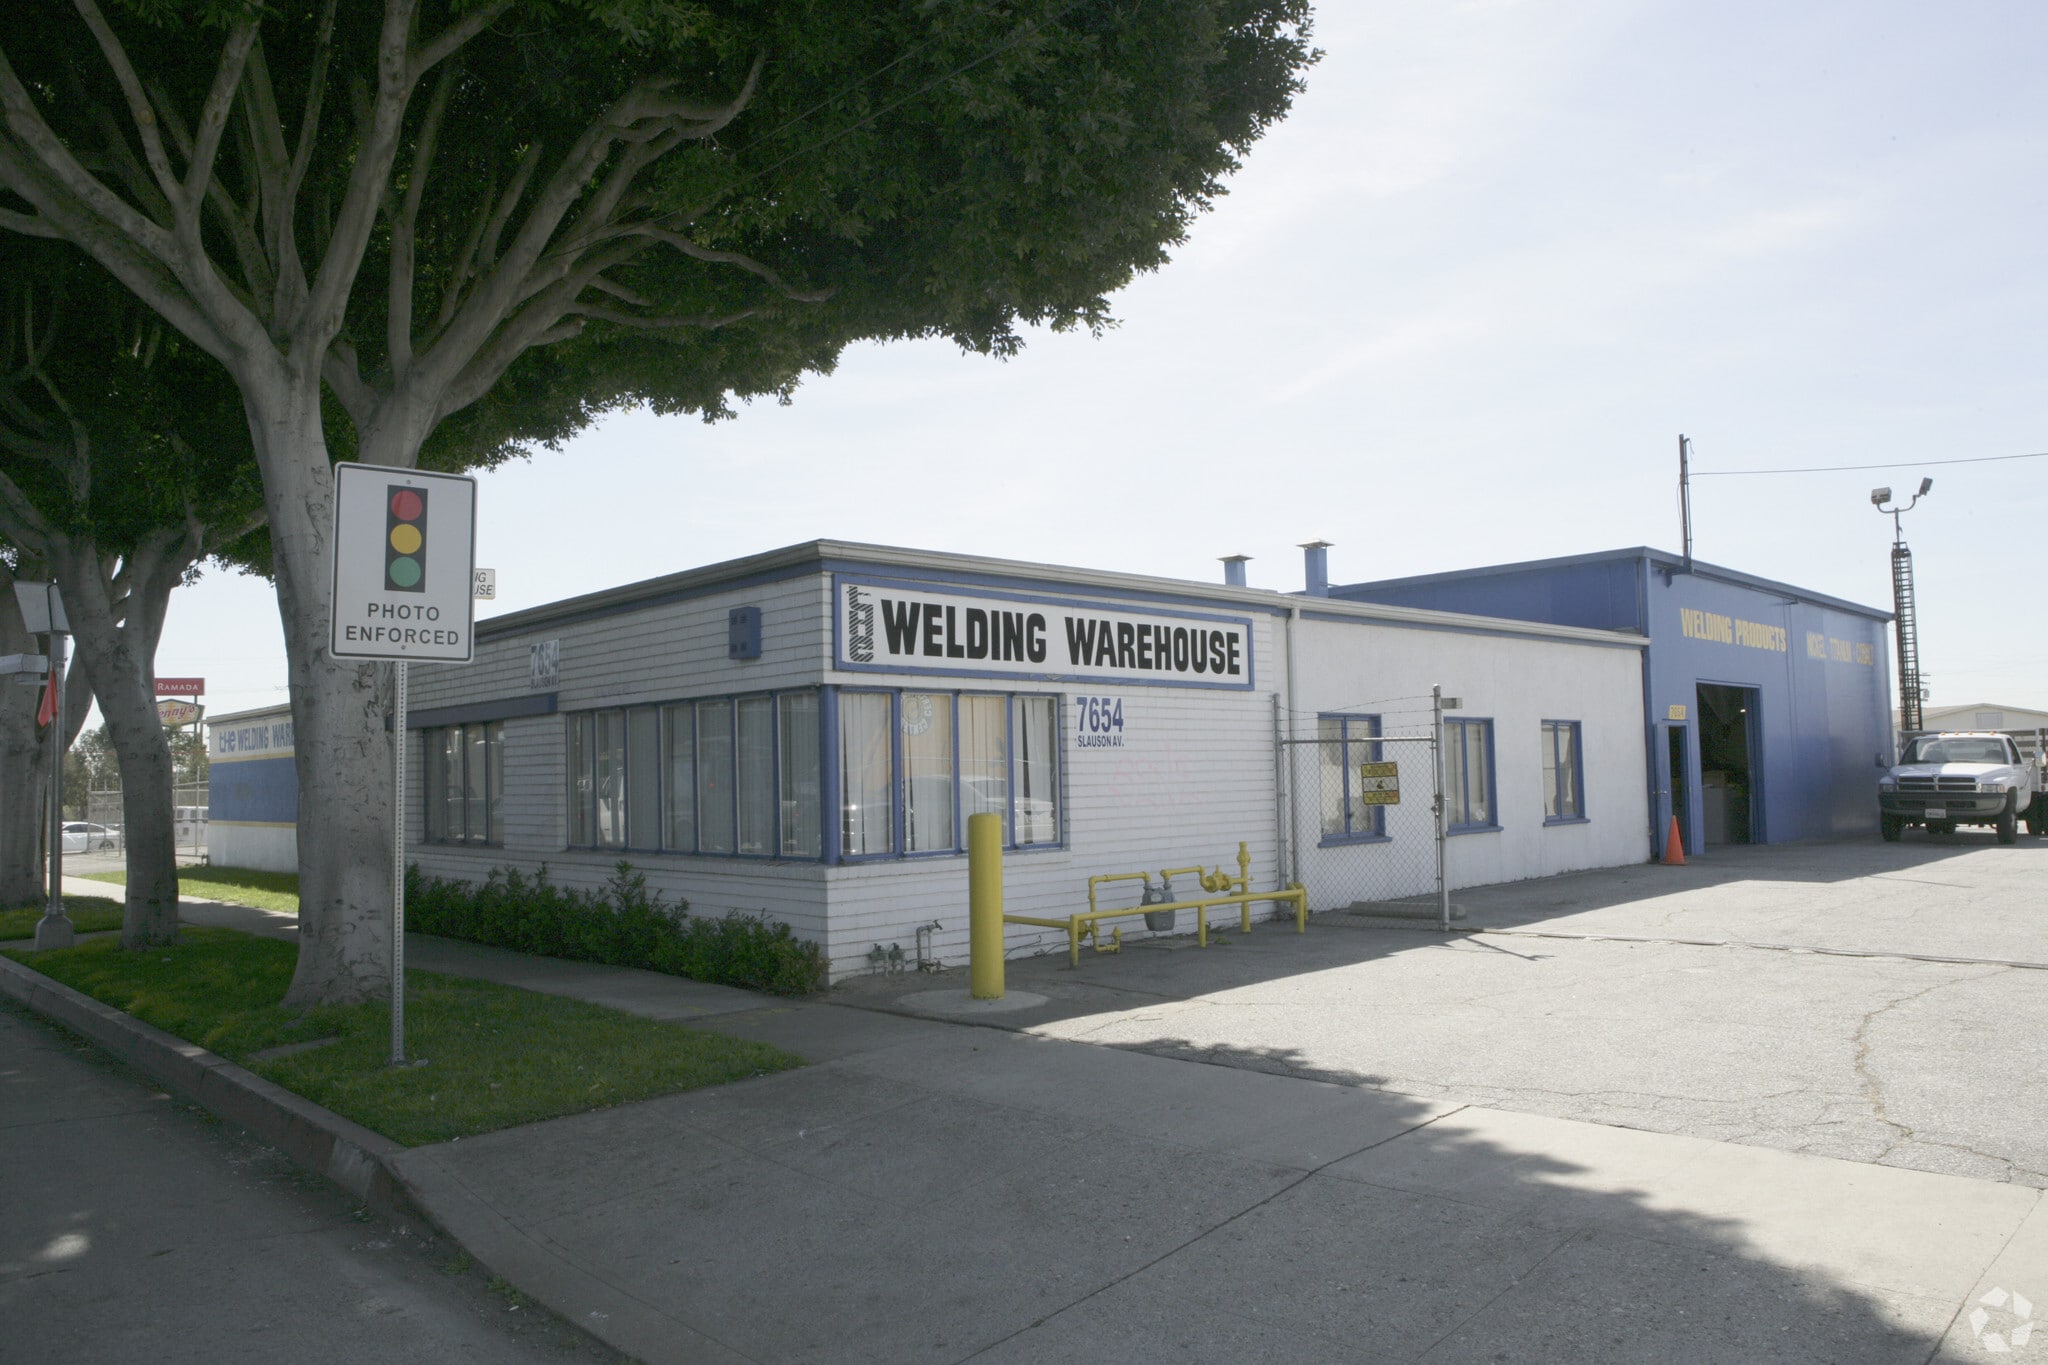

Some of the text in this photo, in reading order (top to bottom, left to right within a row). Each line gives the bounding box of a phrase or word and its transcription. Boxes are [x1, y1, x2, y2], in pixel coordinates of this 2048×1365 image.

[367, 602, 440, 622] PHOTO
[345, 625, 459, 645] ENFORCED
[880, 598, 1047, 664] WELDING
[1064, 616, 1241, 676] WAREHOUSE
[1680, 608, 1787, 653] WELDING PRODUCTS
[157, 682, 199, 691] RAMADA
[1076, 696, 1124, 733] 7654
[237, 726, 269, 752] WELDING
[1077, 735, 1112, 748] SLAUSON
